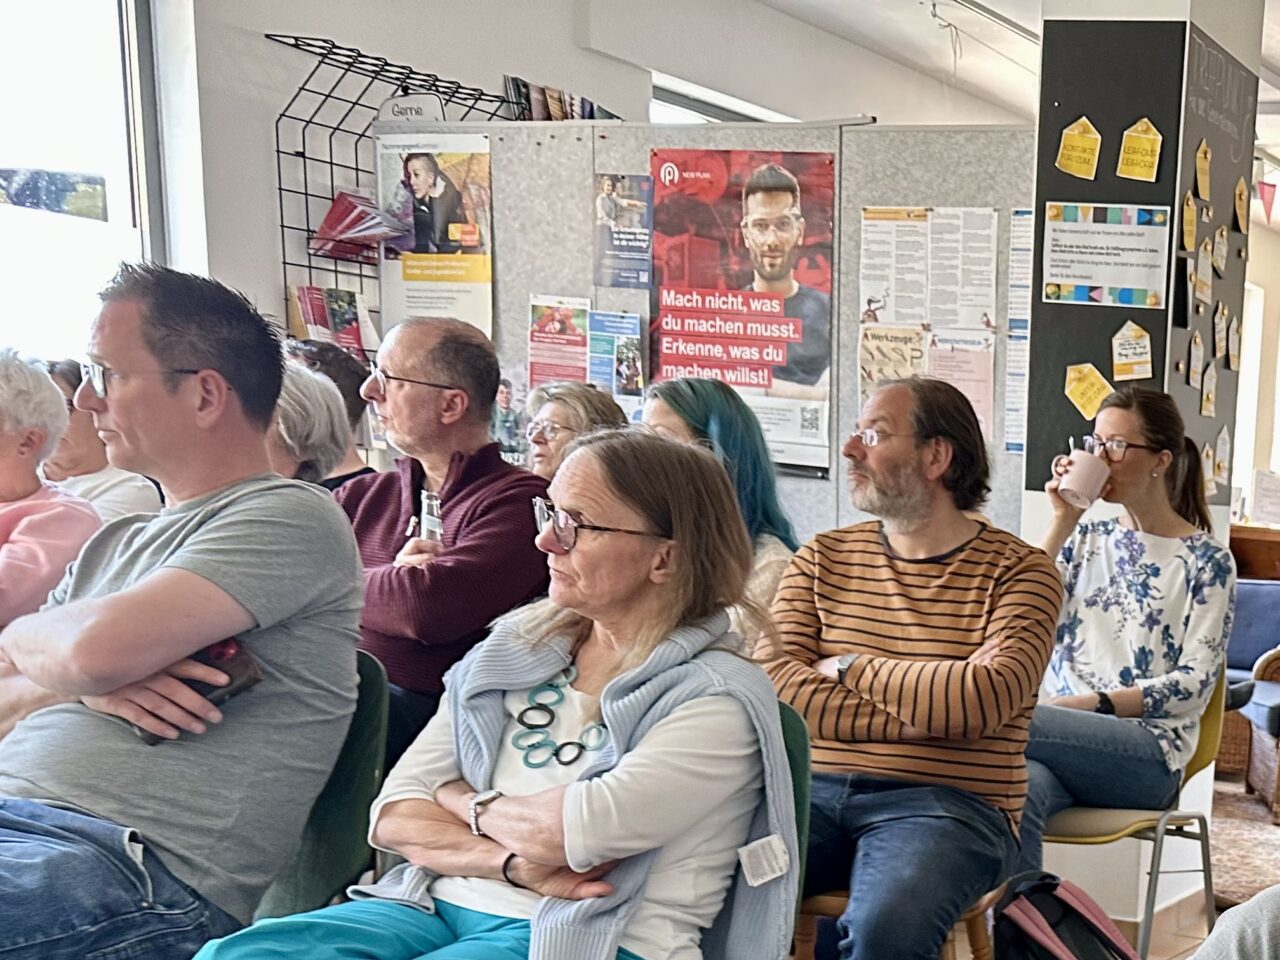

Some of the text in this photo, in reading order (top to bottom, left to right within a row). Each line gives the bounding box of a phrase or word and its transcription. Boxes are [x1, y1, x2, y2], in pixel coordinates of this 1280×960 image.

[662, 289, 780, 312] Mach nicht, was
[662, 314, 800, 339] du machen musst.
[662, 338, 782, 362] Erkenne, was du
[870, 332, 913, 346] Werkzeuge
[662, 364, 768, 385] machen willst!
